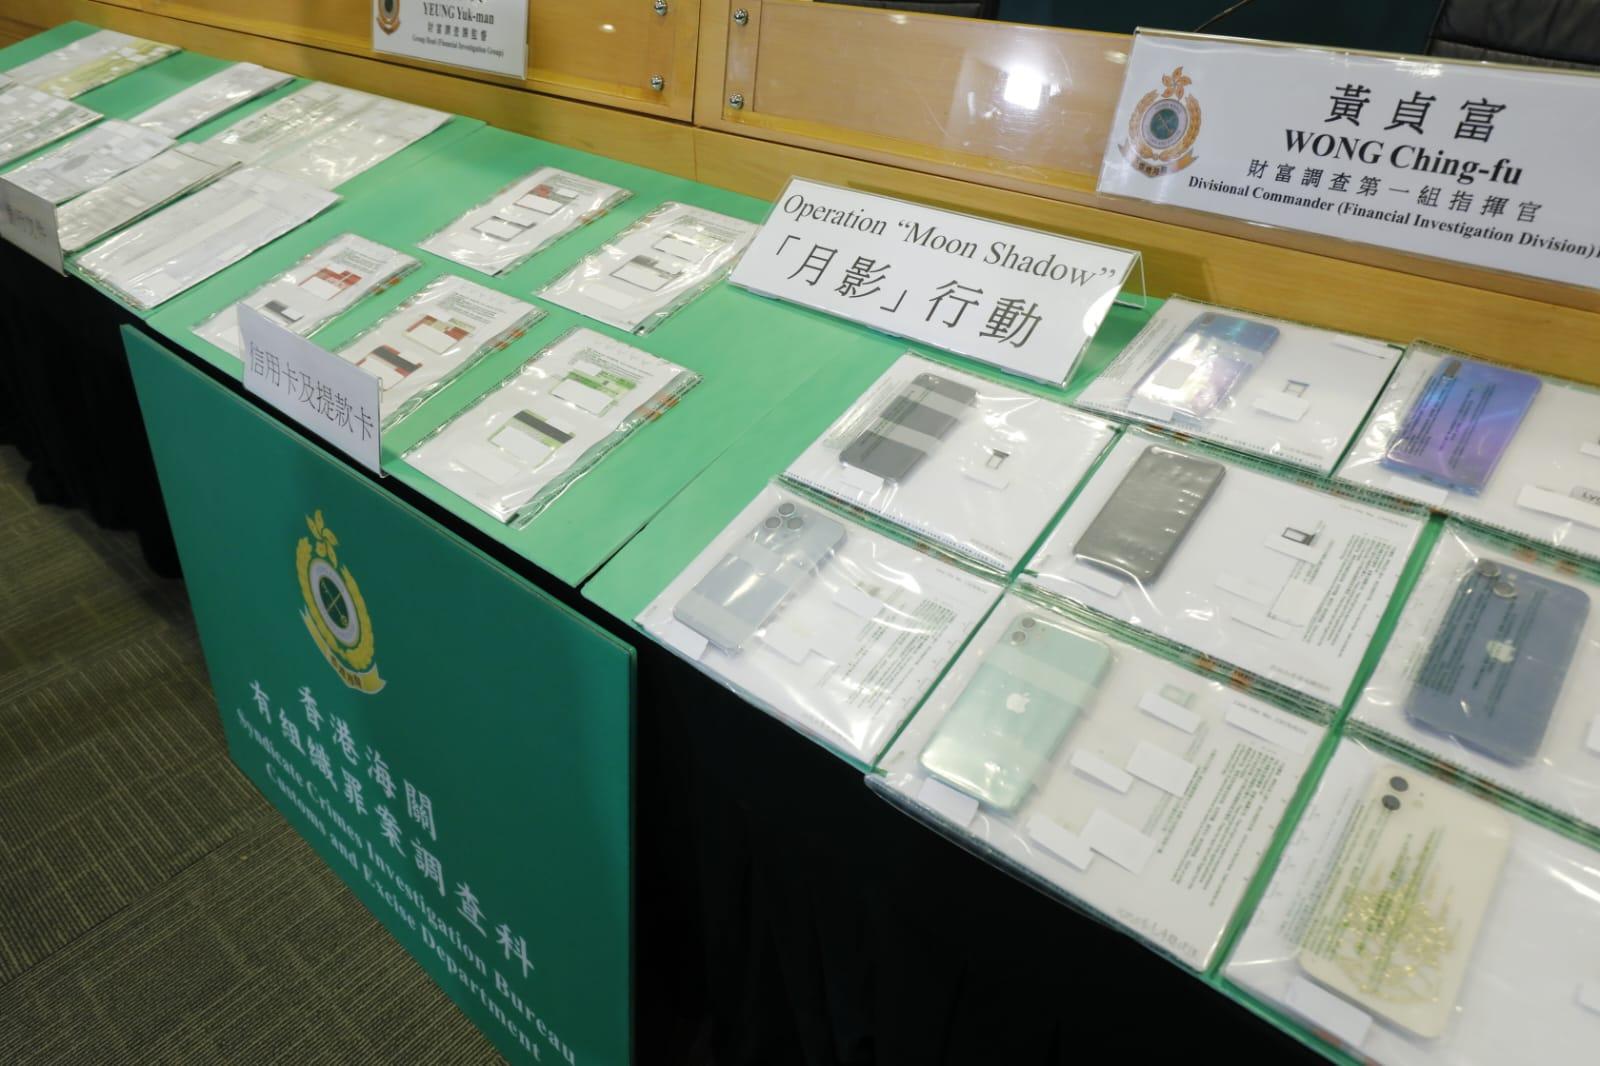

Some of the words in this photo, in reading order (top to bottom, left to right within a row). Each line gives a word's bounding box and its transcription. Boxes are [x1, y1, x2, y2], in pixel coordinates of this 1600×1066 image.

[423, 2, 455, 19] YEUNG
[456, 7, 495, 25] Yuk-man
[1285, 129, 1385, 165] WONG
[1389, 144, 1524, 186] Ching-fu
[1324, 83, 1507, 143] 黃貞富
[1188, 175, 1250, 198] Divisional
[1252, 186, 1336, 212] Commander
[1336, 201, 1411, 226] (Financial
[1412, 213, 1515, 243] Investigation
[1246, 158, 1543, 223] 財富調查第一組指揮官
[783, 194, 888, 236] Operation
[897, 218, 979, 260] “Moon
[982, 241, 1117, 288] Shadow”
[774, 235, 1043, 349] 「月影」行動
[250, 341, 374, 441] 信用卡及提款卡
[298, 686, 436, 841] 香港海關
[250, 679, 535, 979] 有組織罪案調查科
[237, 708, 304, 787] Syndicate
[306, 780, 363, 849] Crimes
[366, 840, 488, 977] Investigation
[494, 968, 576, 1066] Bureau
[265, 762, 327, 836] Customs
[329, 833, 359, 871] and
[362, 863, 417, 931] Excise
[421, 923, 541, 1062] Department
